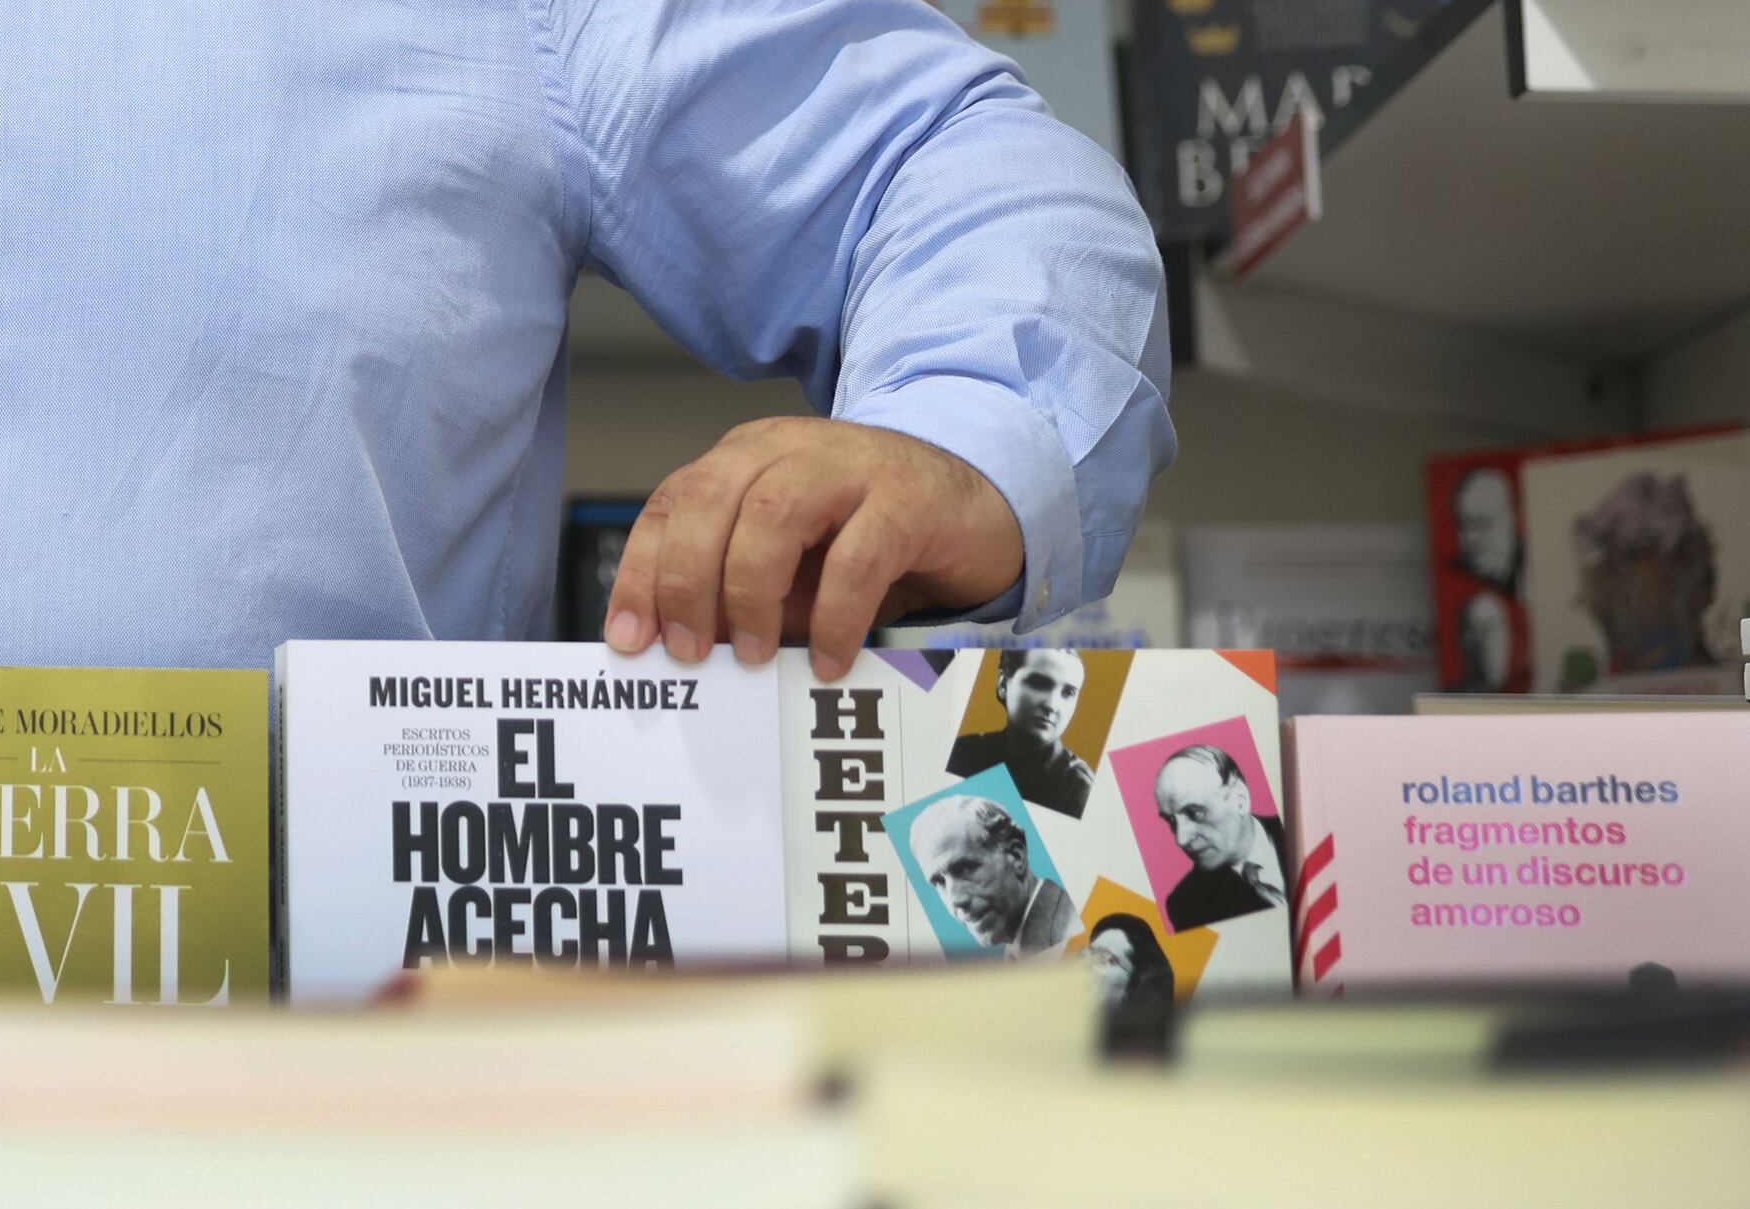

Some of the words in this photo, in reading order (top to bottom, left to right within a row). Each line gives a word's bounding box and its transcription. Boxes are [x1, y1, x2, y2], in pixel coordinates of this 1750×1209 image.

[369, 676, 493, 709] MIGUEL
[500, 670, 699, 710] HERNÁNDEZ
[15, 710, 223, 738] MORADIELLOS
[401, 727, 471, 741] ESCRITOS
[29, 747, 68, 773] LA
[382, 741, 490, 757] PERIODÍSTICOS
[496, 717, 575, 799] EL
[396, 759, 415, 772] DE
[418, 759, 478, 773] GUERRA
[401, 775, 472, 790] (1937-1938)
[1401, 775, 1522, 805] roland
[1531, 775, 1680, 805] barthes
[391, 800, 683, 886] HOMBRE
[1403, 815, 1627, 851] fragmentos
[1407, 856, 1454, 886] de
[1462, 862, 1509, 886] un
[1516, 856, 1685, 886] discurso
[402, 884, 676, 969] ACECHA
[1411, 901, 1582, 928] amoroso
